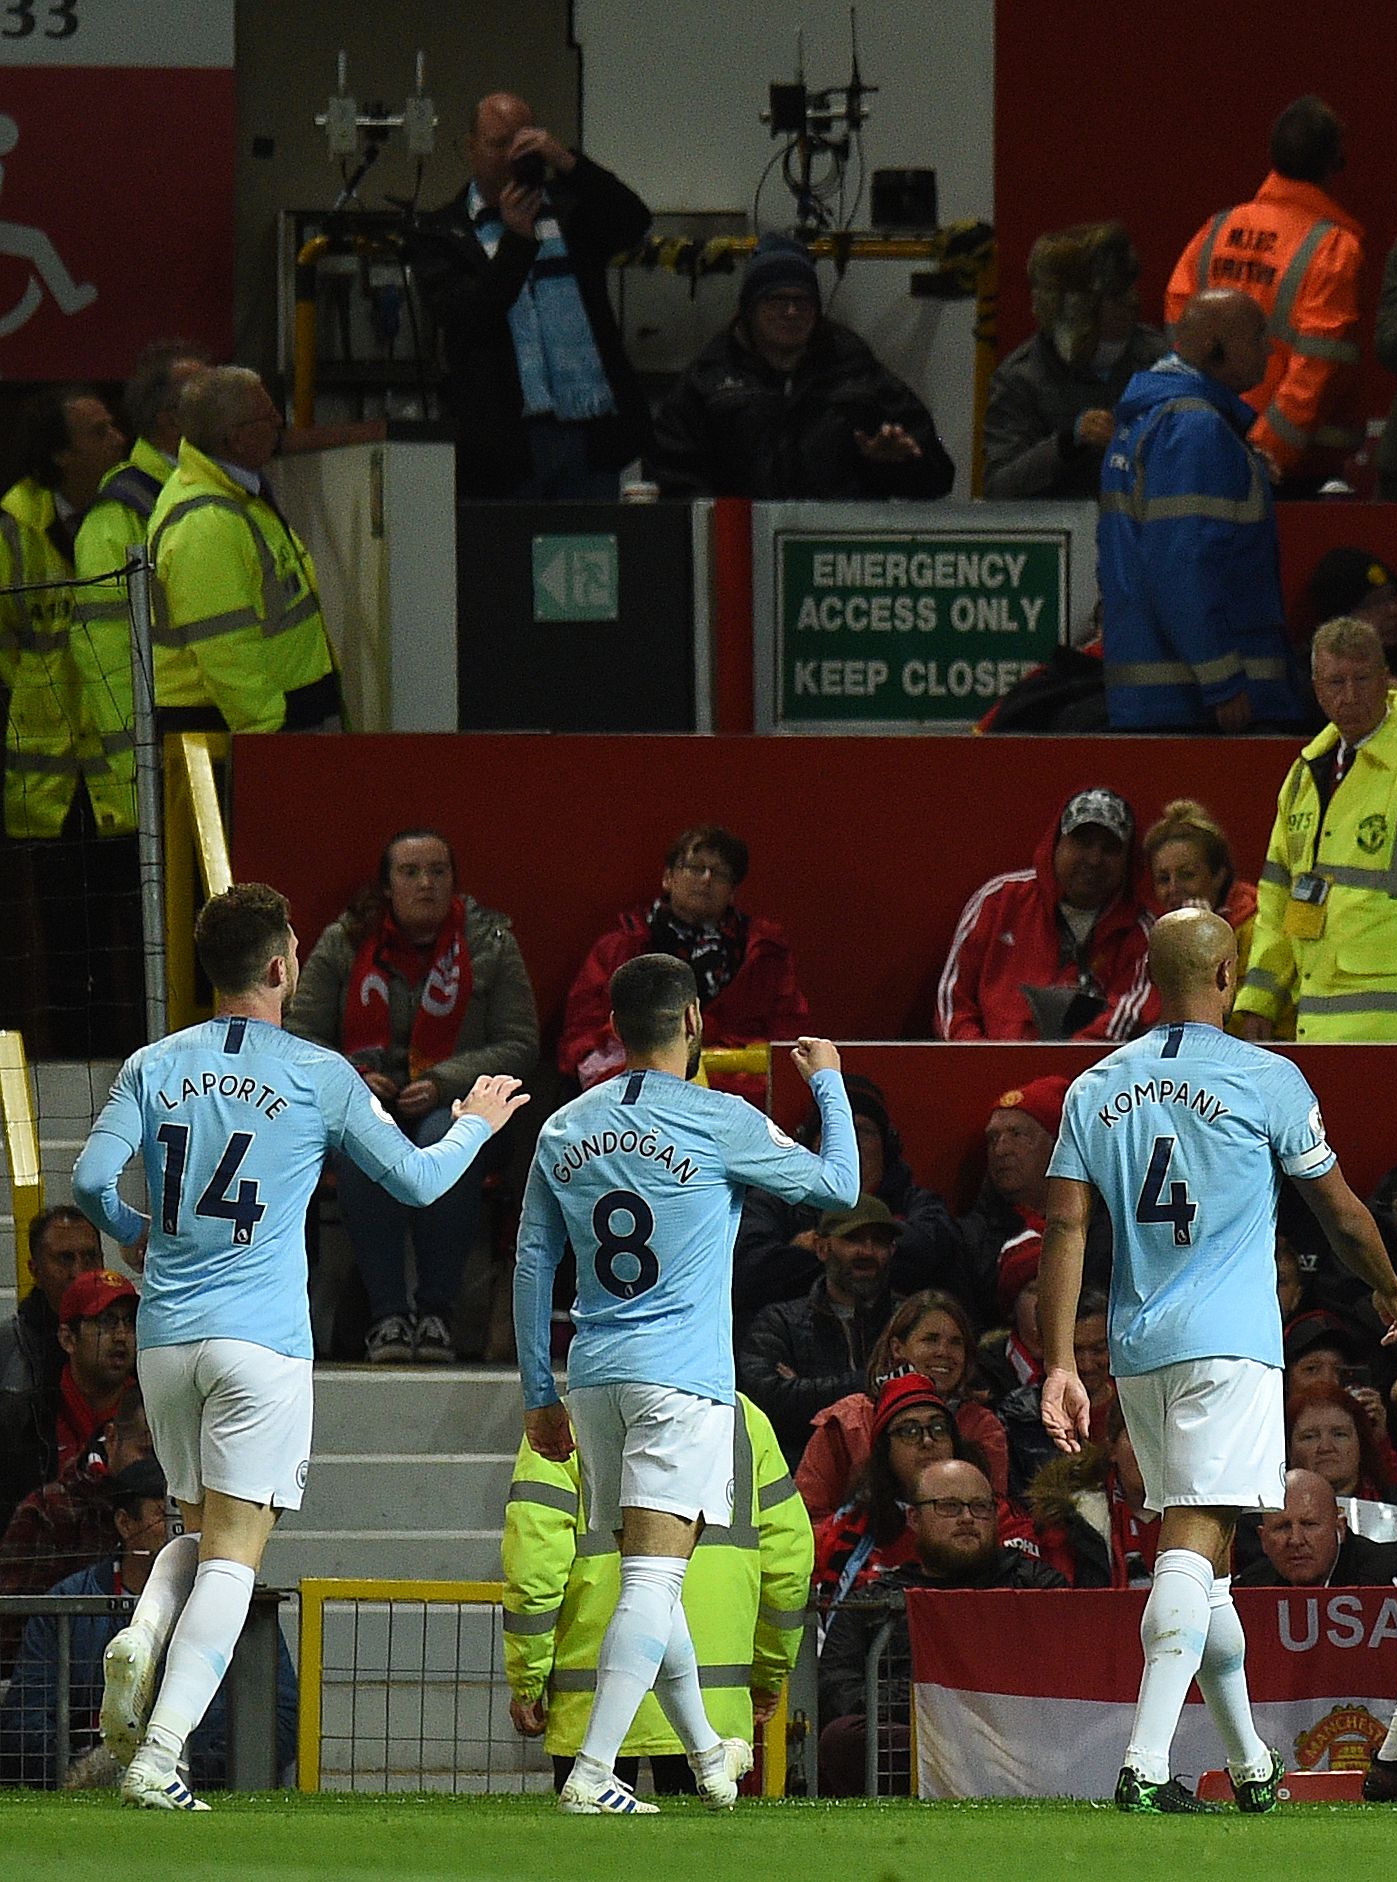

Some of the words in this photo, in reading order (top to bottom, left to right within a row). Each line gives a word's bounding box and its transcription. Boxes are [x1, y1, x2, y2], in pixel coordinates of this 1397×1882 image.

[813, 552, 1028, 588] EMERGENCY
[798, 596, 938, 632] ACCESS
[950, 596, 1045, 632] ONLY
[794, 660, 889, 696] KEEP
[902, 659, 1046, 698] CLOSE
[158, 1073, 288, 1120] LAPORTE
[1098, 1080, 1229, 1128] KOMPANY
[552, 1129, 699, 1184] GÜNDOĞAN
[157, 1124, 266, 1245] 14
[1137, 1137, 1197, 1245] 4
[593, 1190, 659, 1300] 8
